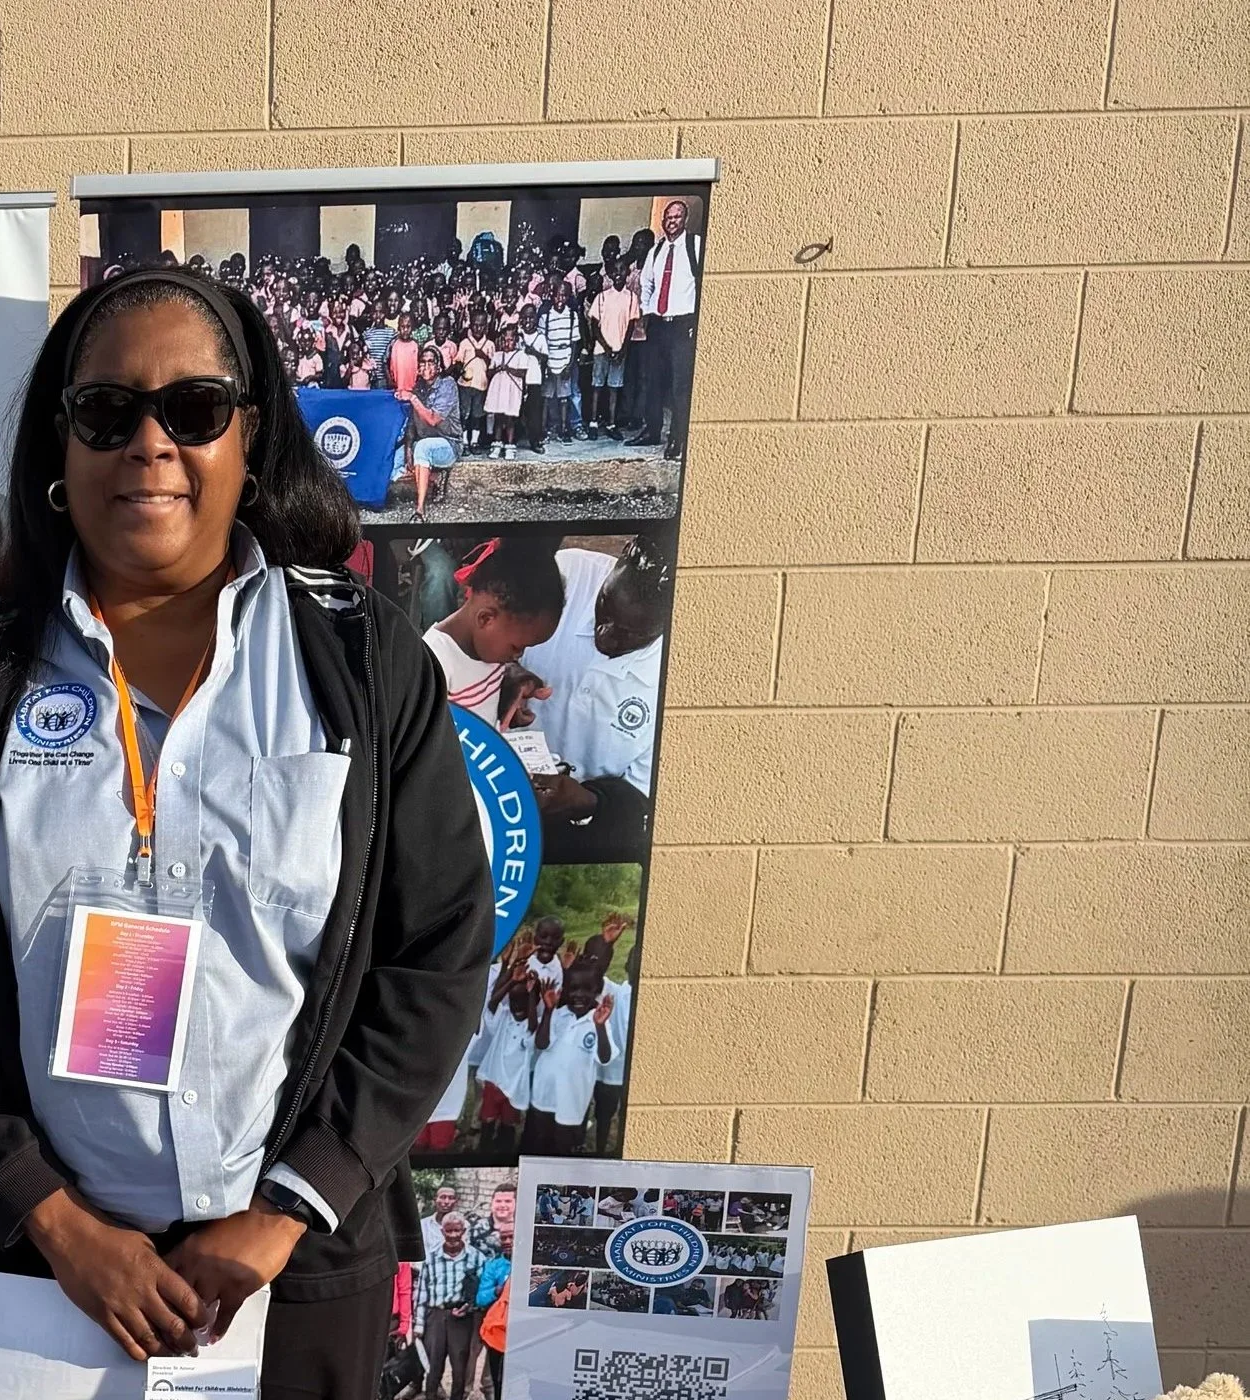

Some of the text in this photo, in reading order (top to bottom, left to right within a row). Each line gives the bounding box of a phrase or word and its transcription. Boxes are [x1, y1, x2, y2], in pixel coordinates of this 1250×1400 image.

[18, 685, 94, 728] HABITAT FOR CHILDREN
[26, 728, 85, 746] MINISTRIES
[458, 727, 527, 918] HILDREN
[614, 1221, 700, 1267] HABITAT FOR CHILDREN
[622, 1266, 690, 1282] MINISTRIES
